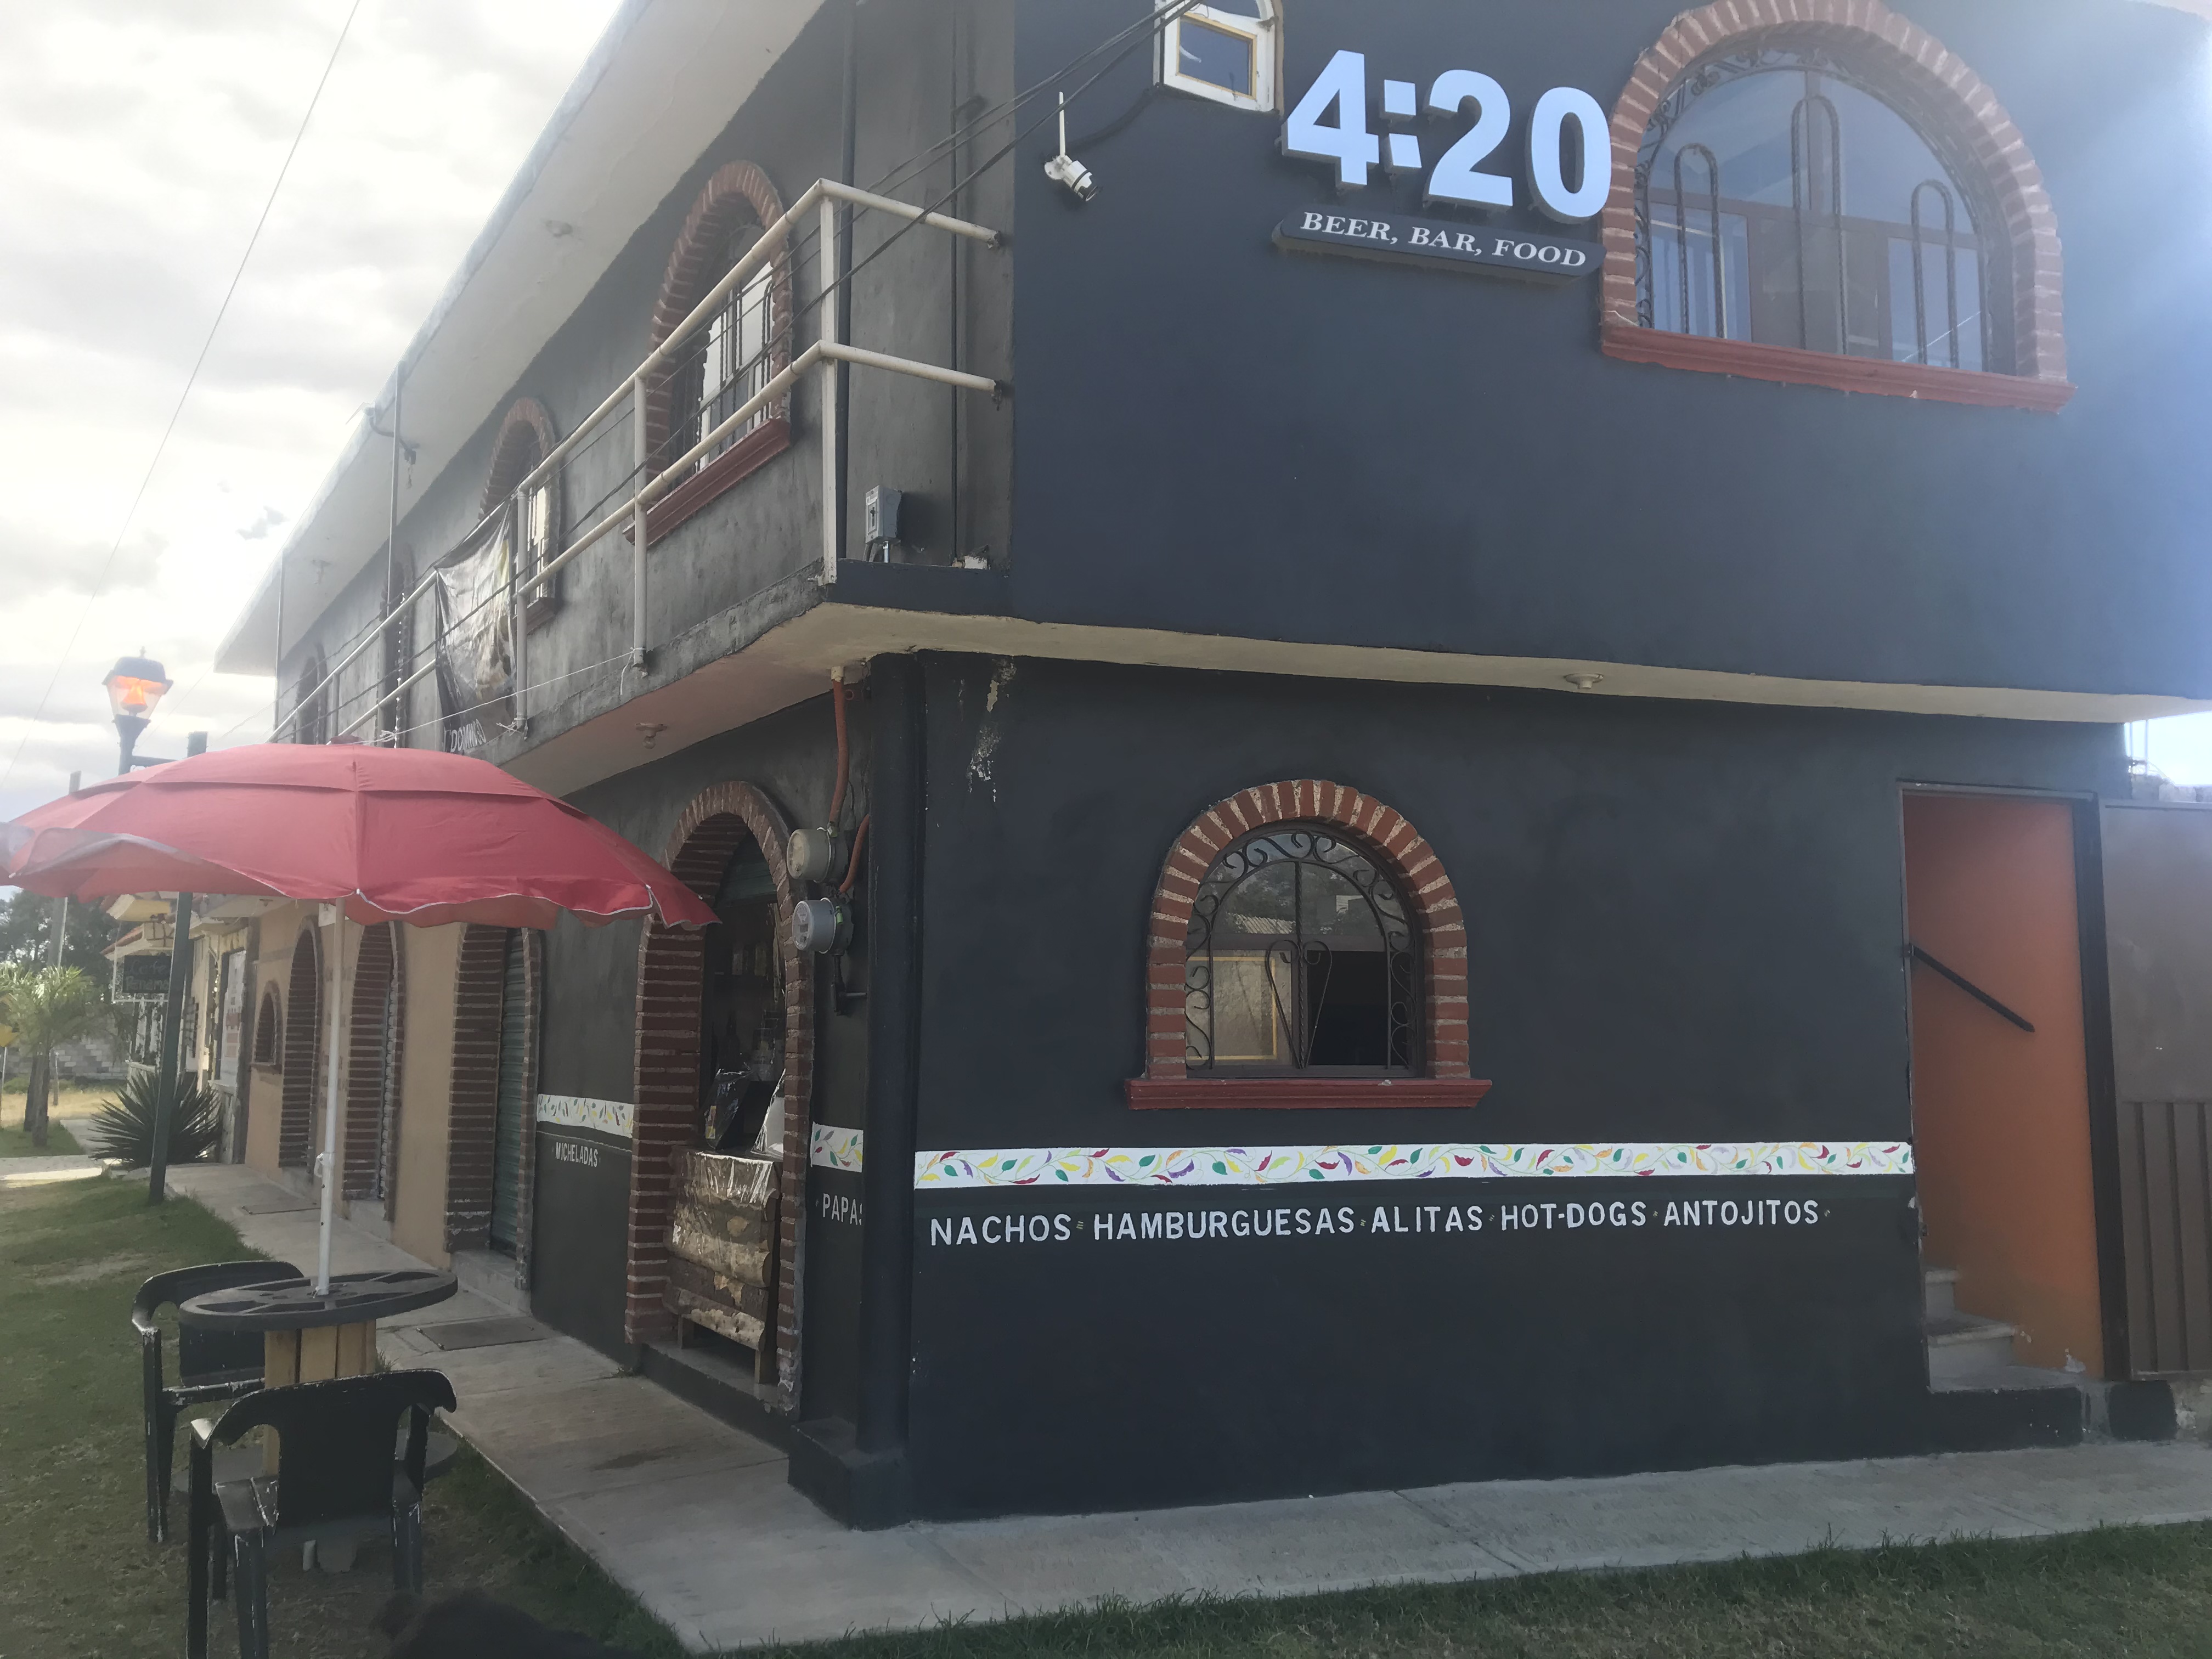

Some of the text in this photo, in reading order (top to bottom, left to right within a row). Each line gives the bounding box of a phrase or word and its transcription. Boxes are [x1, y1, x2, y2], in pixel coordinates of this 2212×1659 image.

[1286, 49, 1611, 218] 4:20
[1300, 212, 1586, 267] BEER, BAR, FOOD
[555, 1142, 599, 1167] MICHELADAS
[930, 1199, 1819, 1246] NACHOS HAMBURGUESAS ALITAS HOT-DOGS ANTOJITOS
